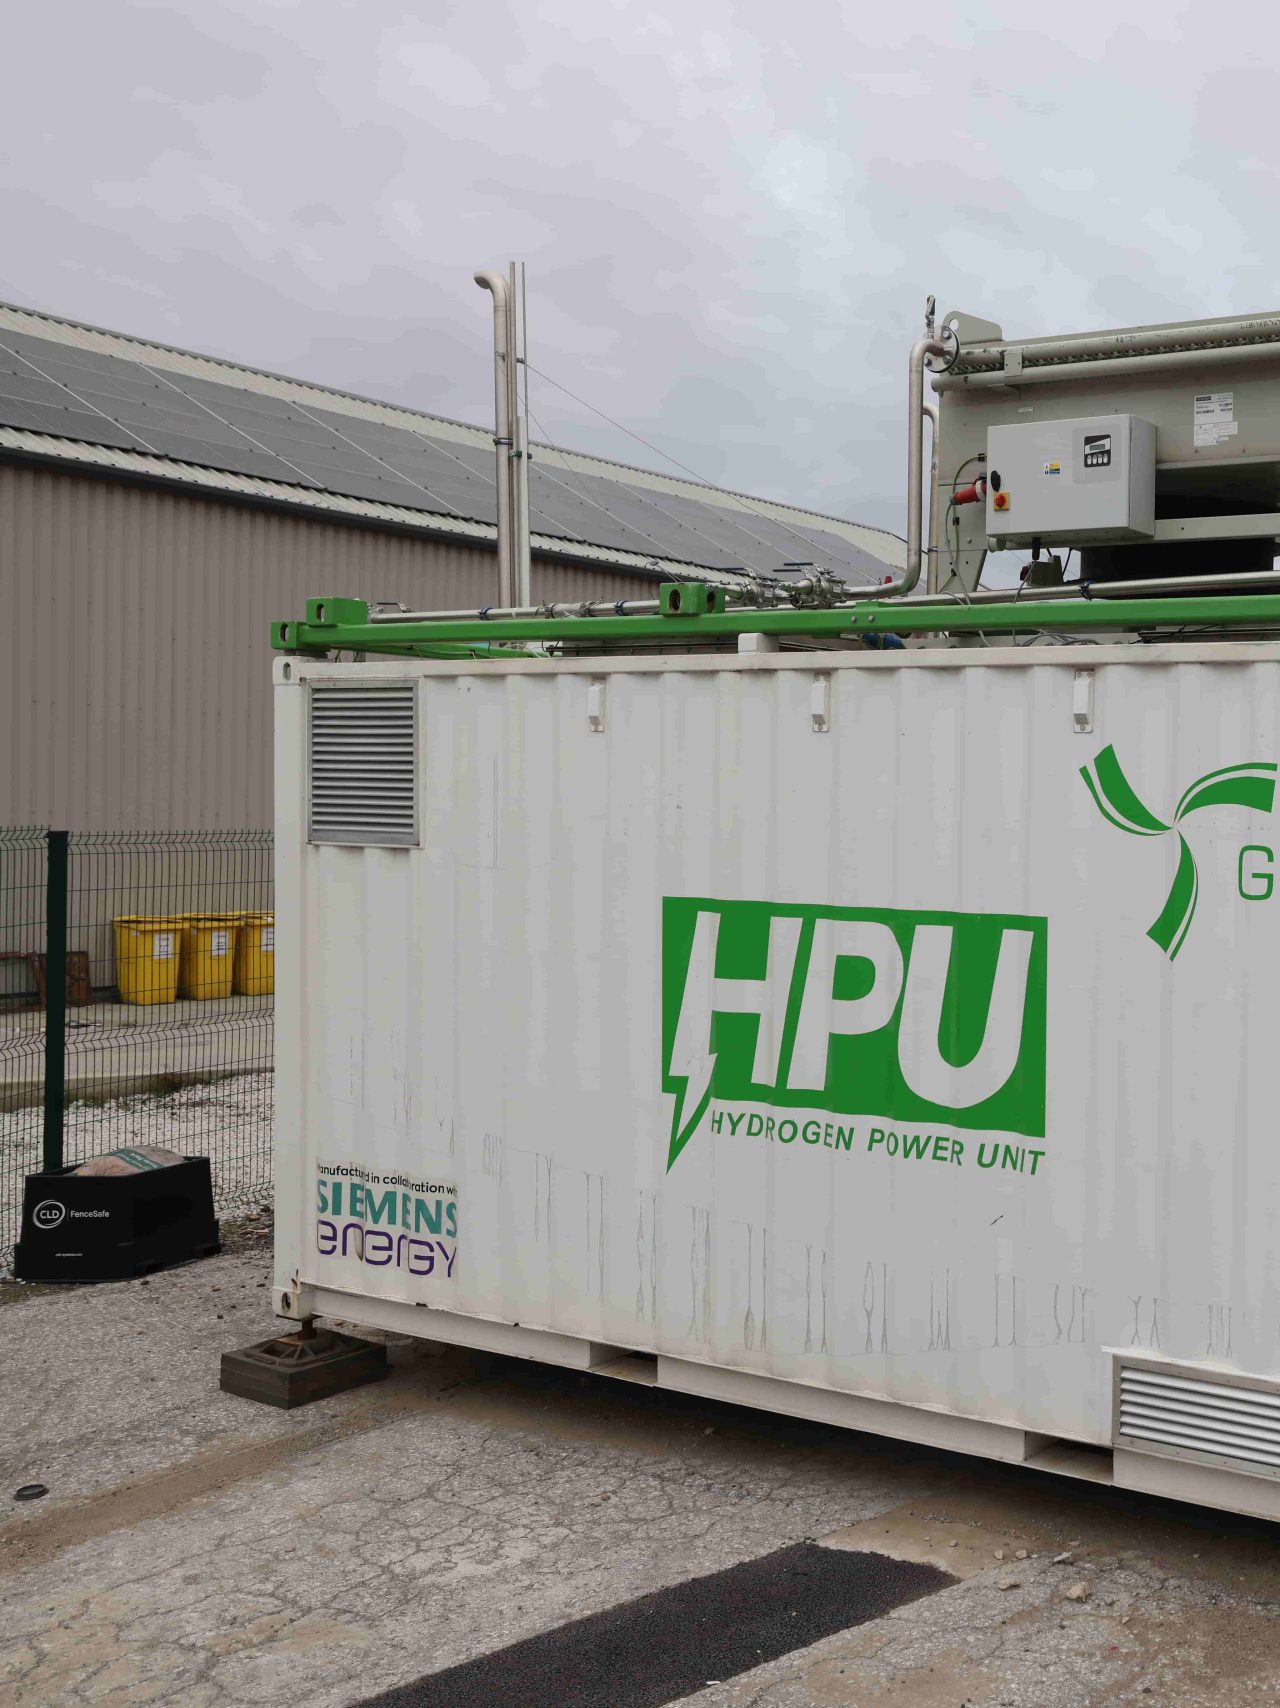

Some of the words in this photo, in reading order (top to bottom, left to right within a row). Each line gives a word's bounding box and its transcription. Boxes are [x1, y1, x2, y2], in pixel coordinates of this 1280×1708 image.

[668, 910, 1035, 1143] HPU
[711, 1109, 855, 1152] HYDROGEN
[867, 1127, 964, 1167] POWER
[976, 1142, 1046, 1176] UNIT
[317, 1163, 370, 1182] anufacturd
[371, 1172, 380, 1184] in
[40, 1210, 60, 1219] CLD
[70, 1209, 110, 1218] FenceSafe
[317, 1178, 458, 1239] SIEMENS
